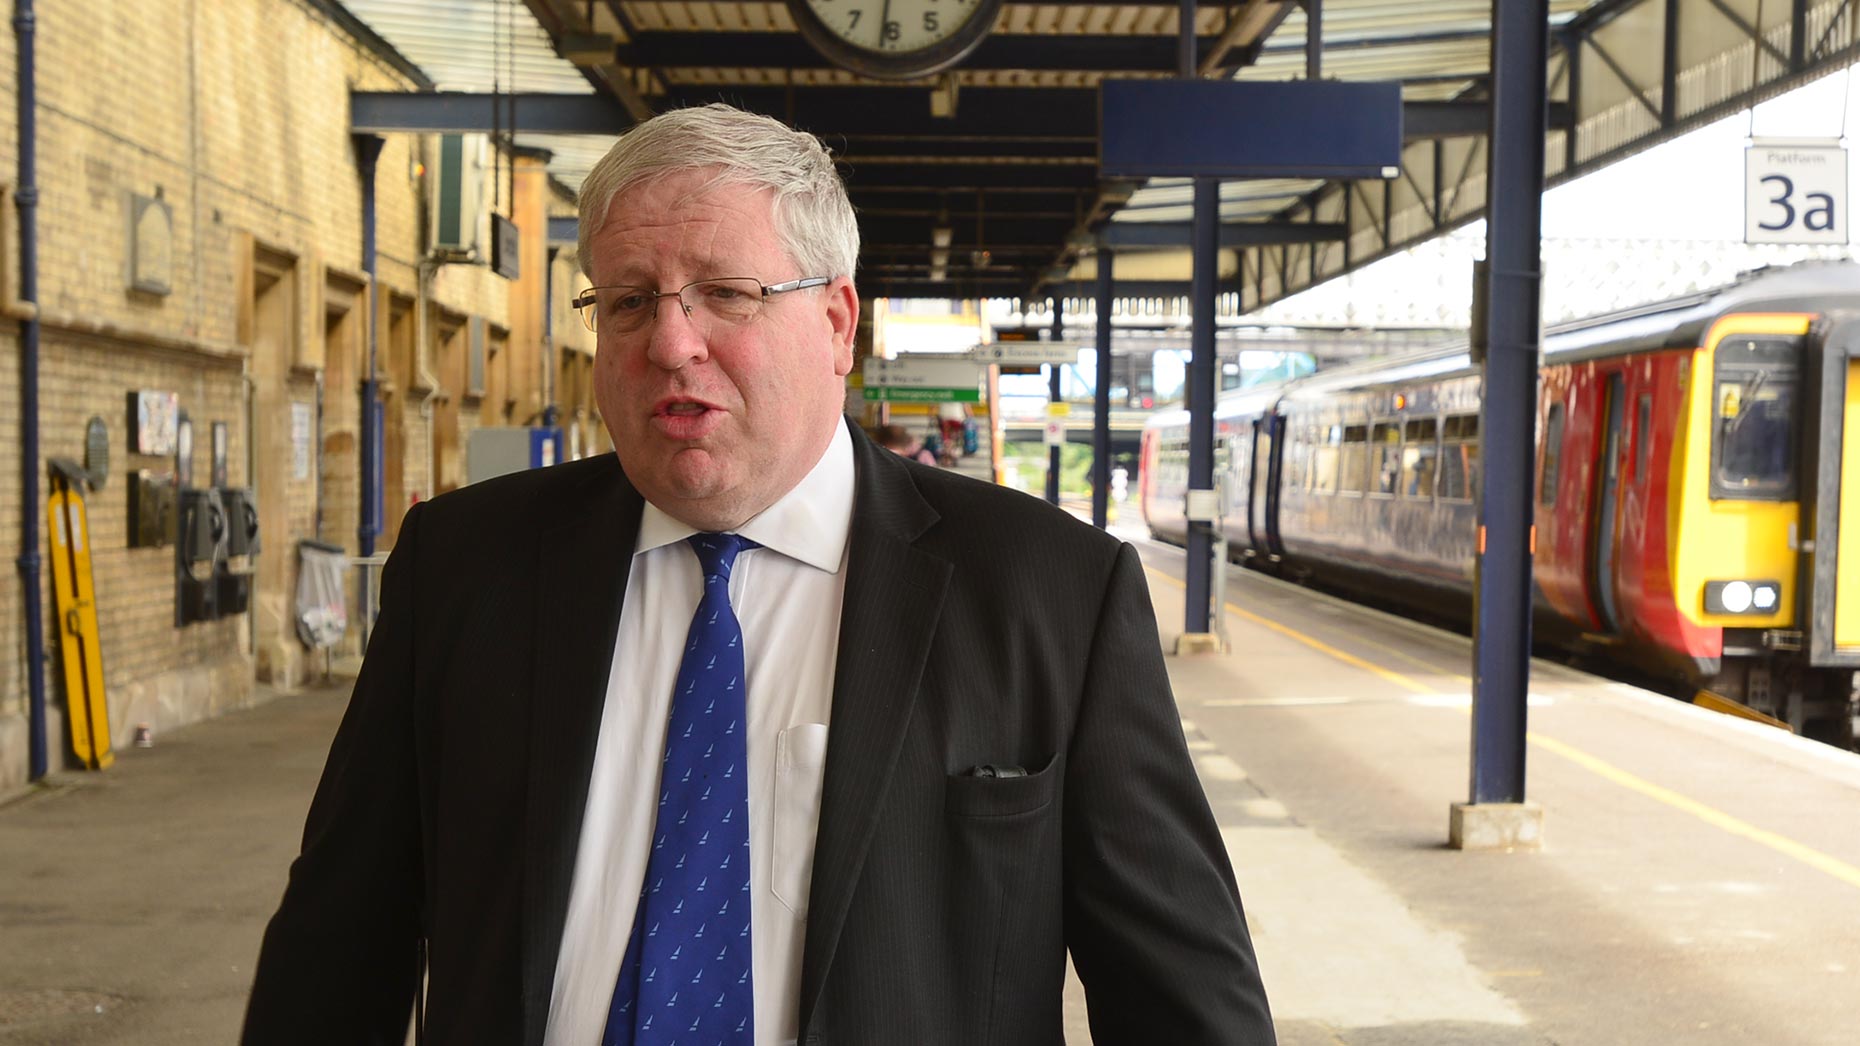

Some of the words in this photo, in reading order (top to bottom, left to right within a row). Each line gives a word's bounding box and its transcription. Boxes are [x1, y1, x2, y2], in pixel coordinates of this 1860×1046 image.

[849, 10, 862, 29] 7
[923, 11, 938, 31] 5
[886, 21, 900, 41] 6
[1767, 151, 1826, 164] Platform
[1758, 174, 1835, 231] 3a
